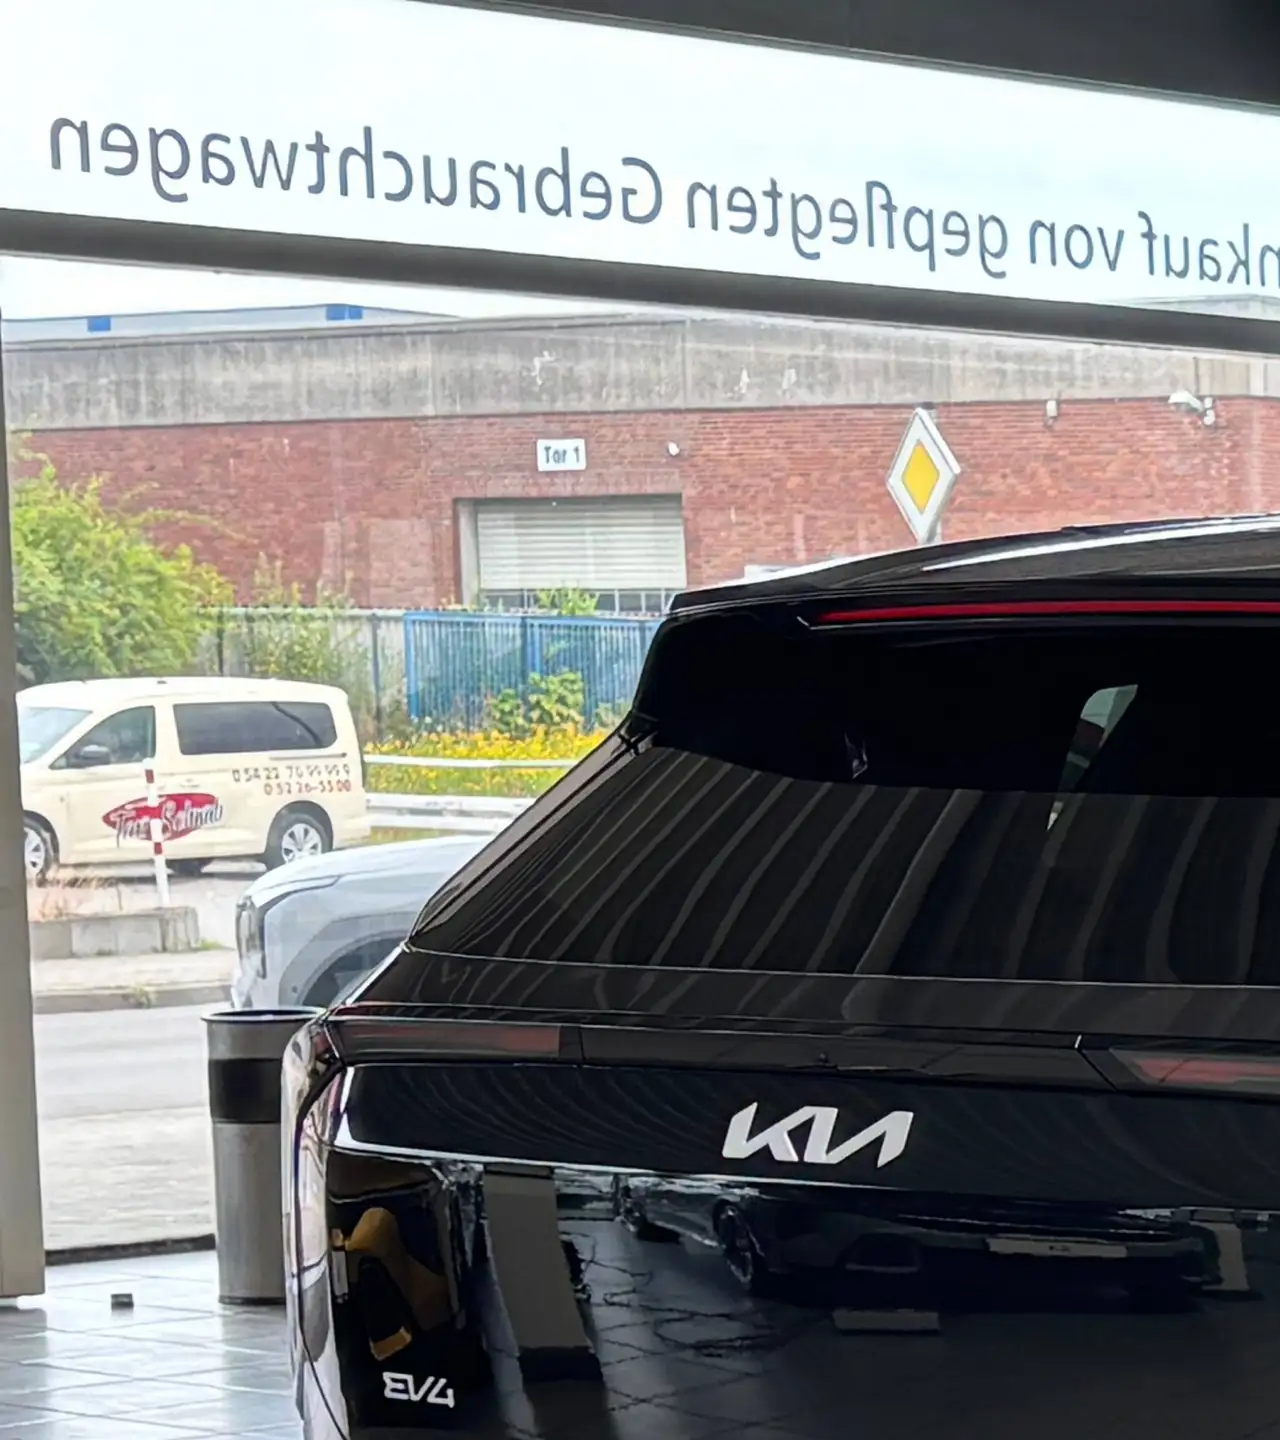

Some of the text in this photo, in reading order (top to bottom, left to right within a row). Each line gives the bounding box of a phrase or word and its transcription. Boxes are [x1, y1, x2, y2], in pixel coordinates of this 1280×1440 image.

[543, 445, 580, 465] Tor 1
[720, 1101, 915, 1168] KIA
[382, 1371, 456, 1409] EV4
